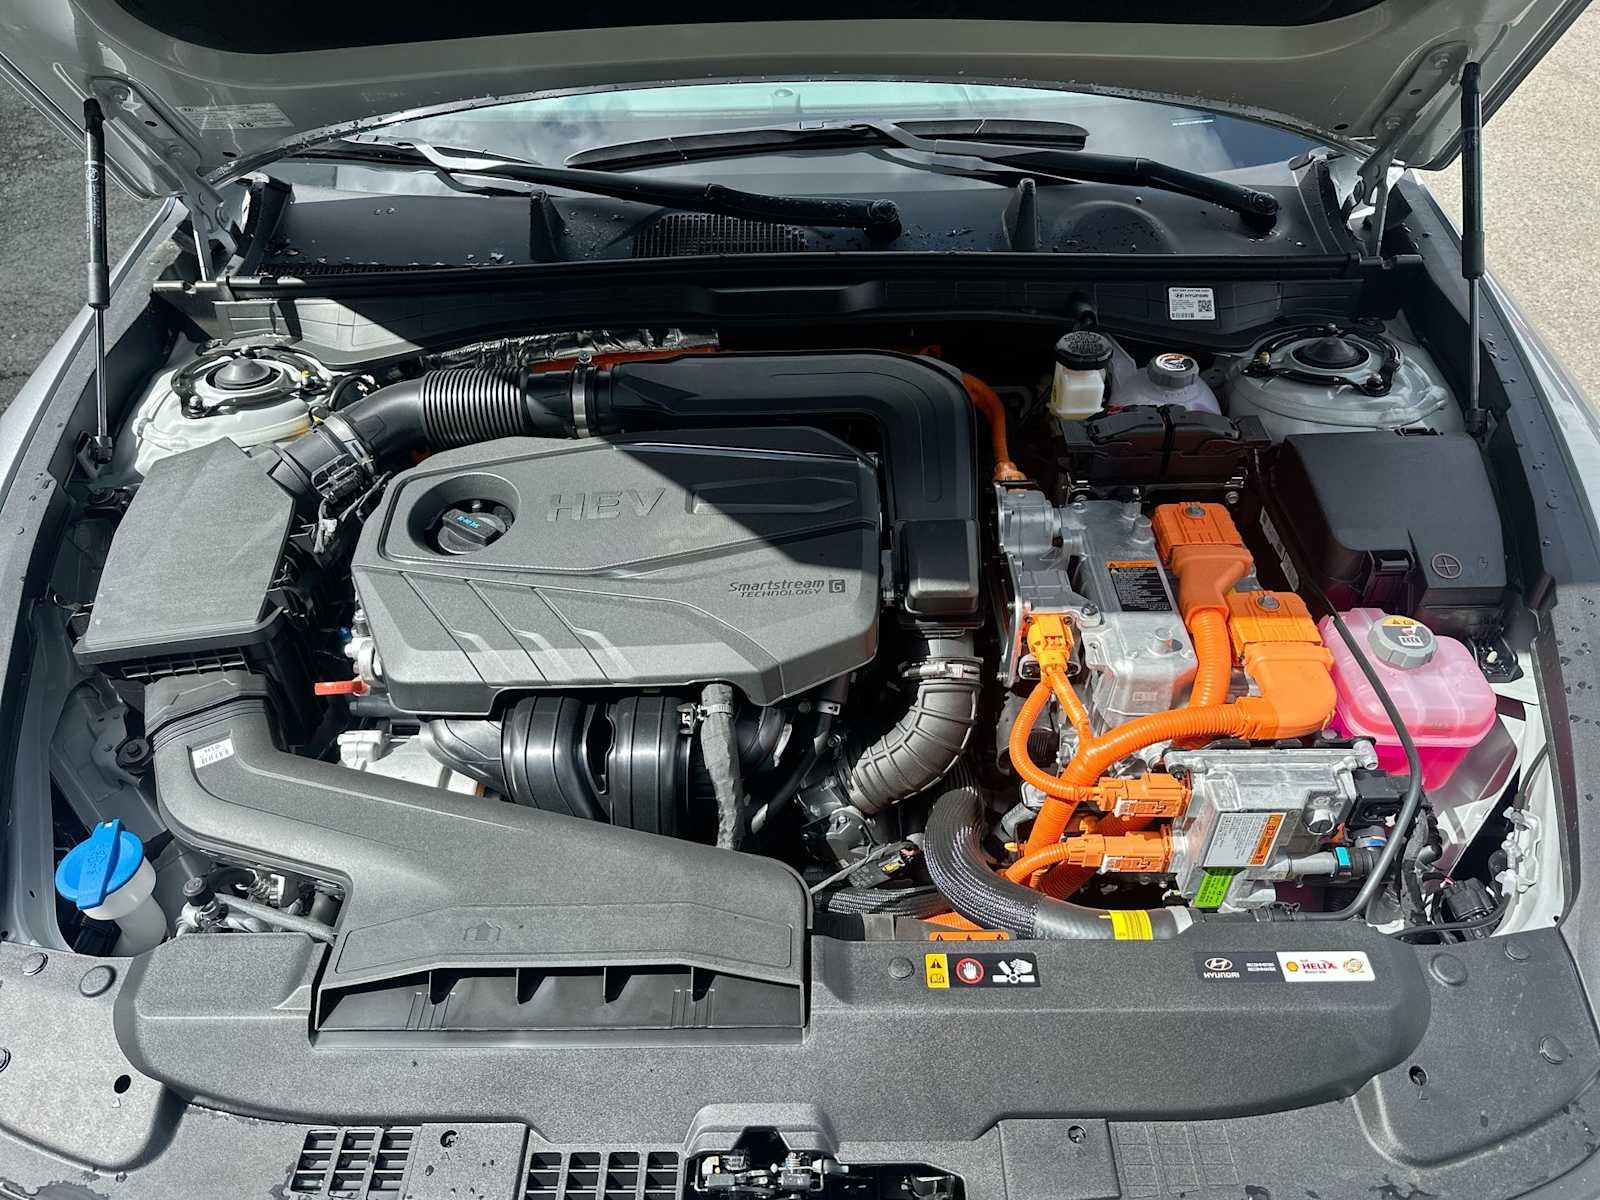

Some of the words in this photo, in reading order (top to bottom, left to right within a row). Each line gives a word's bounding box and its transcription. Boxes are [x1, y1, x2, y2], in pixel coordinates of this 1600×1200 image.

[546, 487, 666, 521] HEV
[728, 579, 825, 592] Smartstream
[740, 588, 821, 598] TECHNOLOGY
[1302, 962, 1335, 970] HELIX
